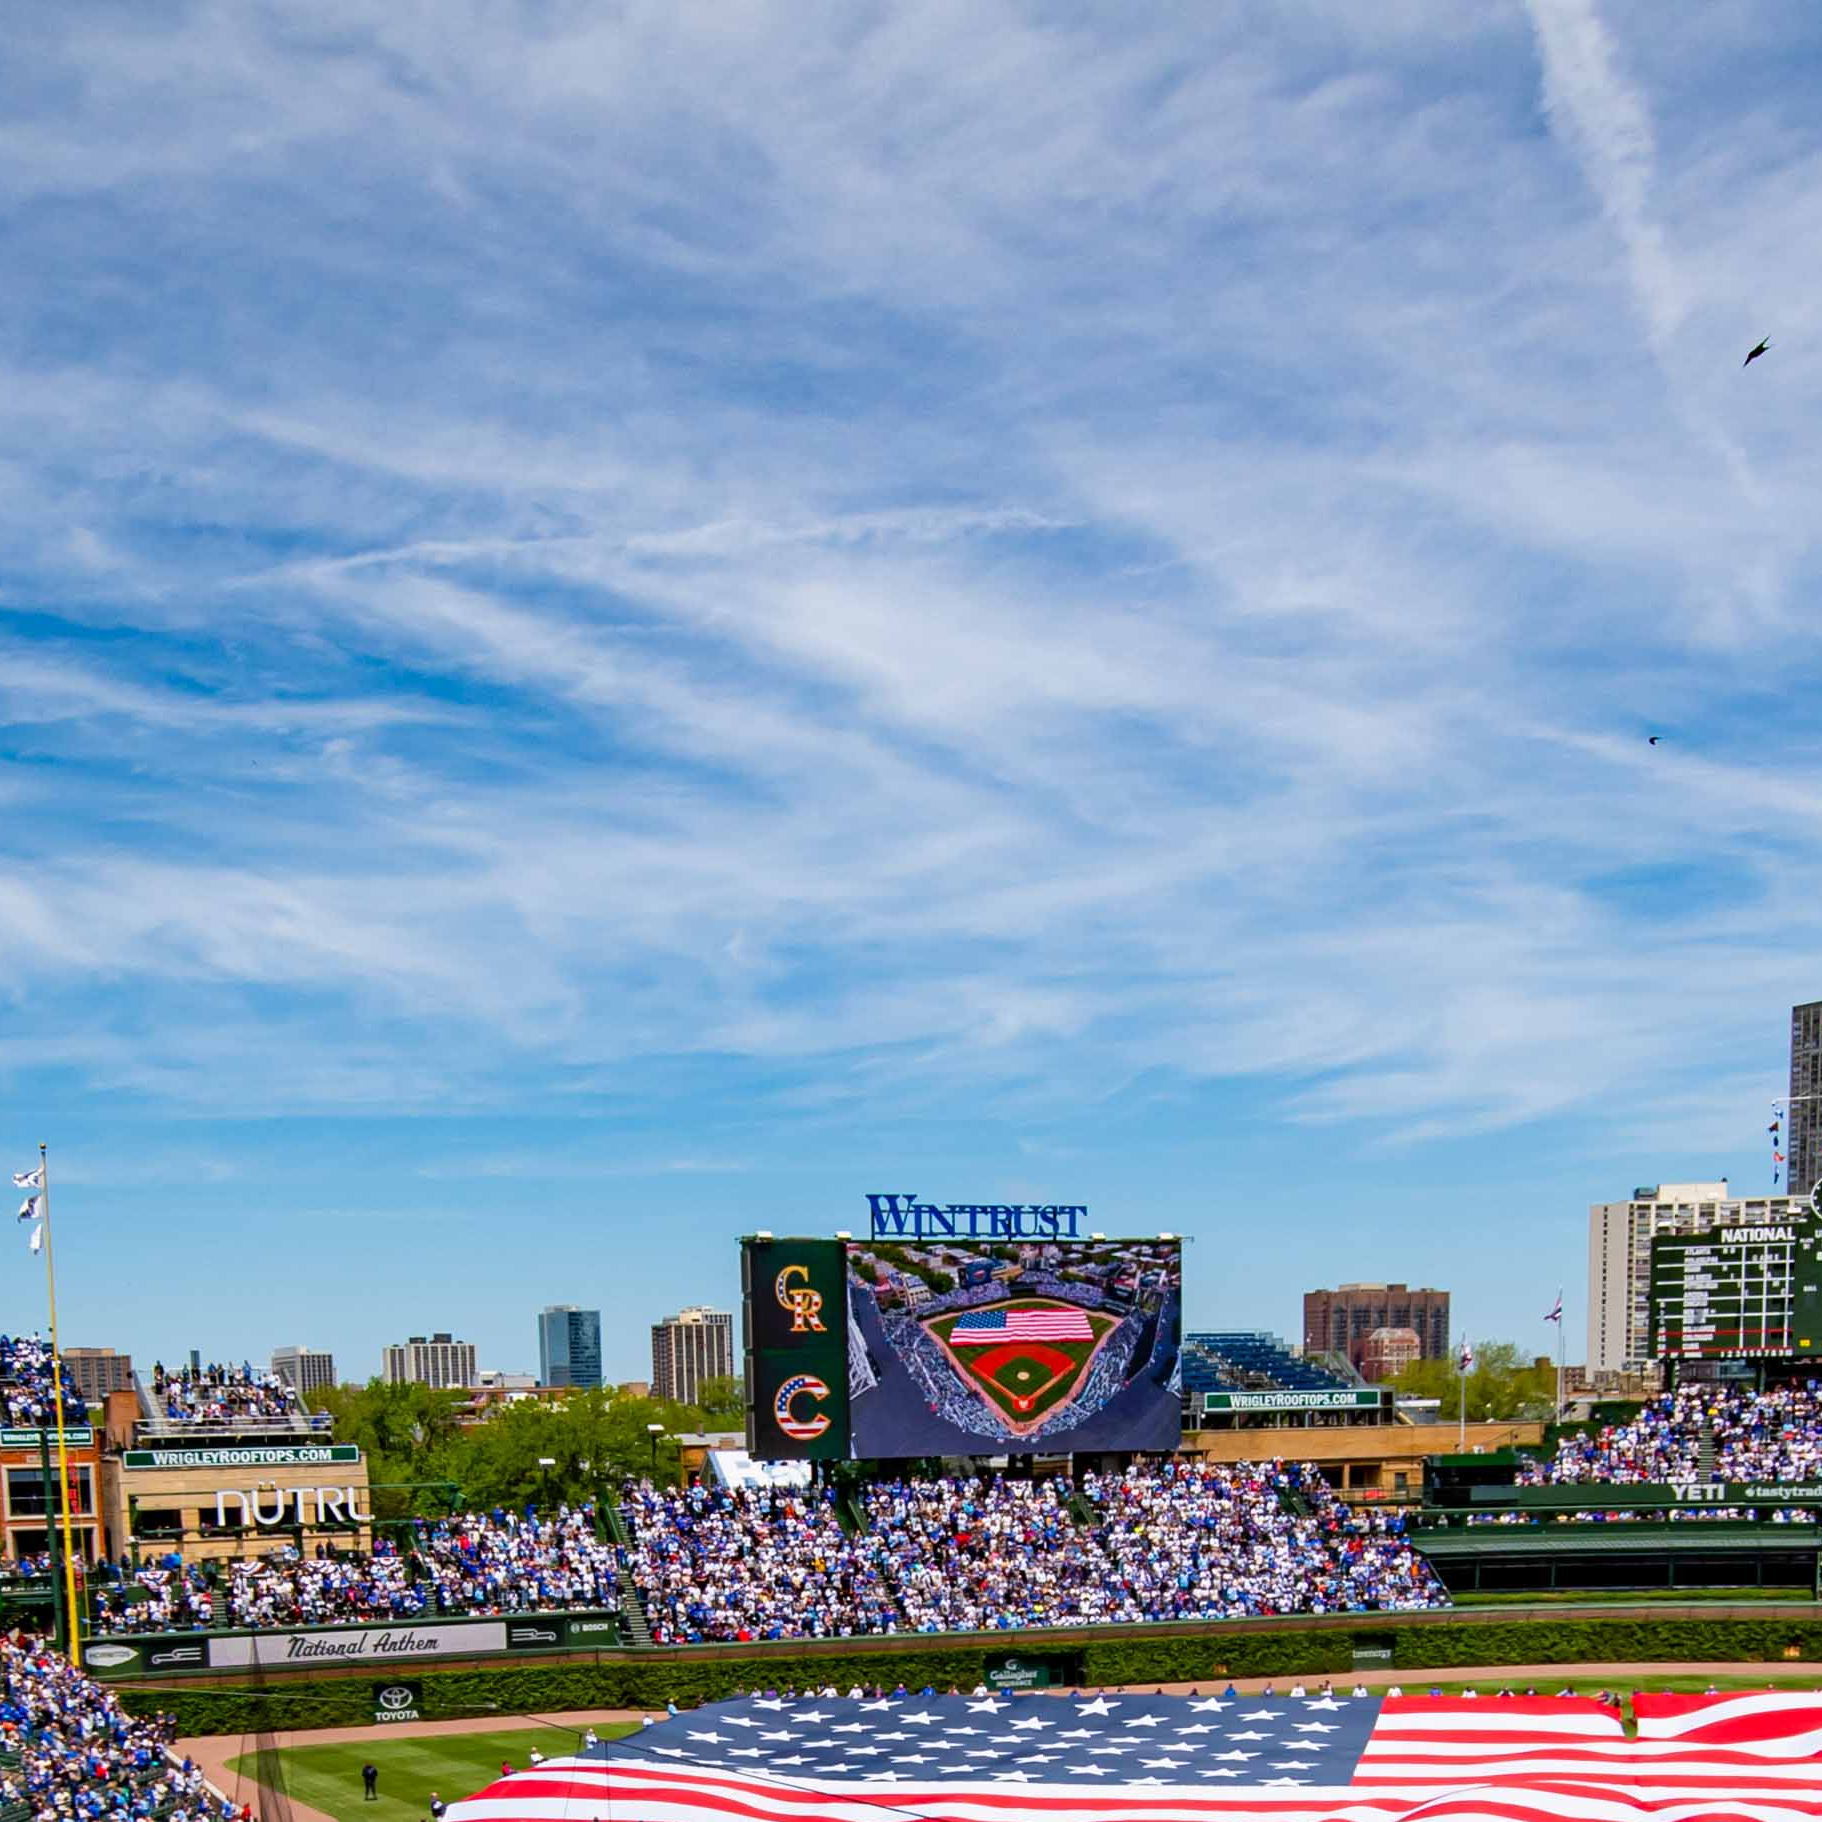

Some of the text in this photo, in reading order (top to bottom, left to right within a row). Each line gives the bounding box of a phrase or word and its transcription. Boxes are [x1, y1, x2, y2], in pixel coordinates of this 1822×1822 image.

[866, 1194, 1088, 1237] WINTRUST
[1721, 1226, 1796, 1243] NATIONAL
[1229, 1393, 1357, 1408] WRIGLEYROOFTOPS.COM
[153, 1449, 332, 1466] WRIGLEYROOFTOPS.COM
[1672, 1483, 1725, 1500] YETI
[287, 1632, 441, 1658] National Anthem
[375, 1710, 420, 1722] TOYOTA
